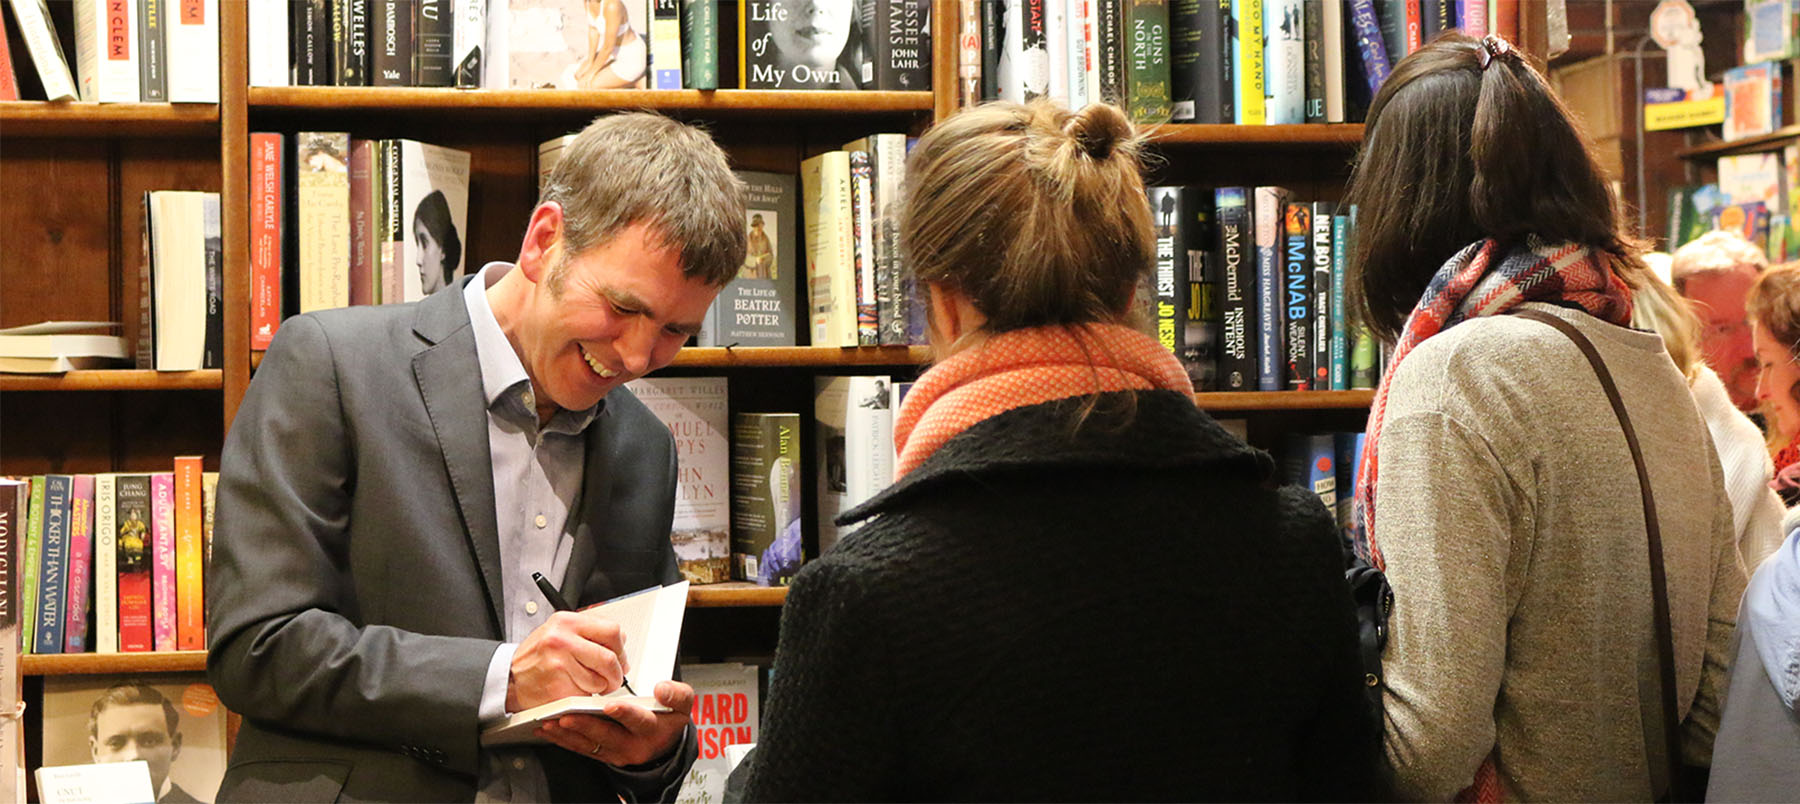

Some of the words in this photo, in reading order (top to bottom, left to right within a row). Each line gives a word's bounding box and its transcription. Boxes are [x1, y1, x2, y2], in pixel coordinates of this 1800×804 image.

[752, 3, 789, 22] Life
[889, 0, 904, 45] IAMS
[904, 1, 919, 45] ESSEE
[1106, 1, 1115, 43] MICHAEL
[1252, 0, 1261, 20] GO
[112, 17, 124, 57] CLEM
[352, 0, 365, 56] WELLES
[1252, 25, 1262, 45] MY
[752, 33, 773, 56] of
[890, 49, 919, 59] JOHN
[1076, 39, 1085, 54] GUY
[1134, 18, 1146, 71] NORTH
[1151, 24, 1164, 65] GUNS
[383, 69, 400, 80] Yale
[752, 64, 786, 88] My
[791, 64, 841, 84] Own
[890, 59, 920, 69] LAHR
[1076, 55, 1086, 97] BROWNING
[1107, 46, 1116, 85] CHABON
[1253, 50, 1263, 91] HAND
[264, 141, 274, 162] JANE
[264, 164, 275, 193] WELSH
[392, 145, 400, 197] CONGENIAL
[839, 178, 847, 212] ARIEL
[264, 194, 275, 230] CARLYLE
[330, 214, 341, 233] The
[392, 199, 400, 233] SPIRITS
[1315, 214, 1330, 243] NEW
[1335, 224, 1344, 240] The
[208, 250, 217, 266] THE
[838, 236, 846, 267] MORRIS
[892, 232, 900, 260] bacon
[1157, 236, 1174, 258] THE
[1315, 245, 1330, 274] BOY
[1335, 241, 1344, 256] End
[208, 267, 217, 290] WHITE
[892, 261, 900, 270] in
[1157, 259, 1174, 298] THIRST
[1226, 231, 1242, 302] McDermid
[1261, 257, 1271, 277] MISS
[737, 287, 752, 297] THE
[752, 288, 766, 297] LIFE
[766, 289, 776, 298] OF
[891, 271, 900, 291] your
[1287, 242, 1306, 320] McNAB
[734, 299, 781, 312] BEATRIX
[892, 293, 901, 318] blood
[1157, 301, 1175, 317] JO
[1262, 277, 1271, 332] HARGREAVES
[1318, 291, 1326, 314] TRACY
[735, 314, 780, 327] POTTER
[1225, 311, 1236, 357] INTENT
[1234, 306, 1245, 360] INSIDIOUS
[1318, 314, 1326, 352] CHEVALIER
[1289, 321, 1298, 363] WEAPON
[1297, 325, 1306, 359] SILENT
[668, 421, 714, 437] MUEL
[779, 425, 791, 454] Alan
[677, 438, 706, 454] PYS
[679, 467, 703, 482] HN
[779, 457, 792, 503] Bennett
[101, 480, 110, 507] IRIS
[119, 489, 147, 497] CHANG
[159, 484, 169, 517] ADULT
[682, 484, 715, 500] LYN
[48, 494, 63, 545] THICKER
[72, 497, 81, 537] MASTERS
[80, 499, 89, 537] Alexander
[101, 509, 111, 546] ORIGO
[159, 518, 169, 569] FANTASY
[0, 512, 8, 617] MODIGLIANI
[46, 547, 60, 583] THAN
[74, 559, 83, 575] life
[43, 586, 58, 627] WATER
[72, 576, 83, 622] discarded
[691, 692, 749, 725] ARD
[697, 725, 752, 760] SON
